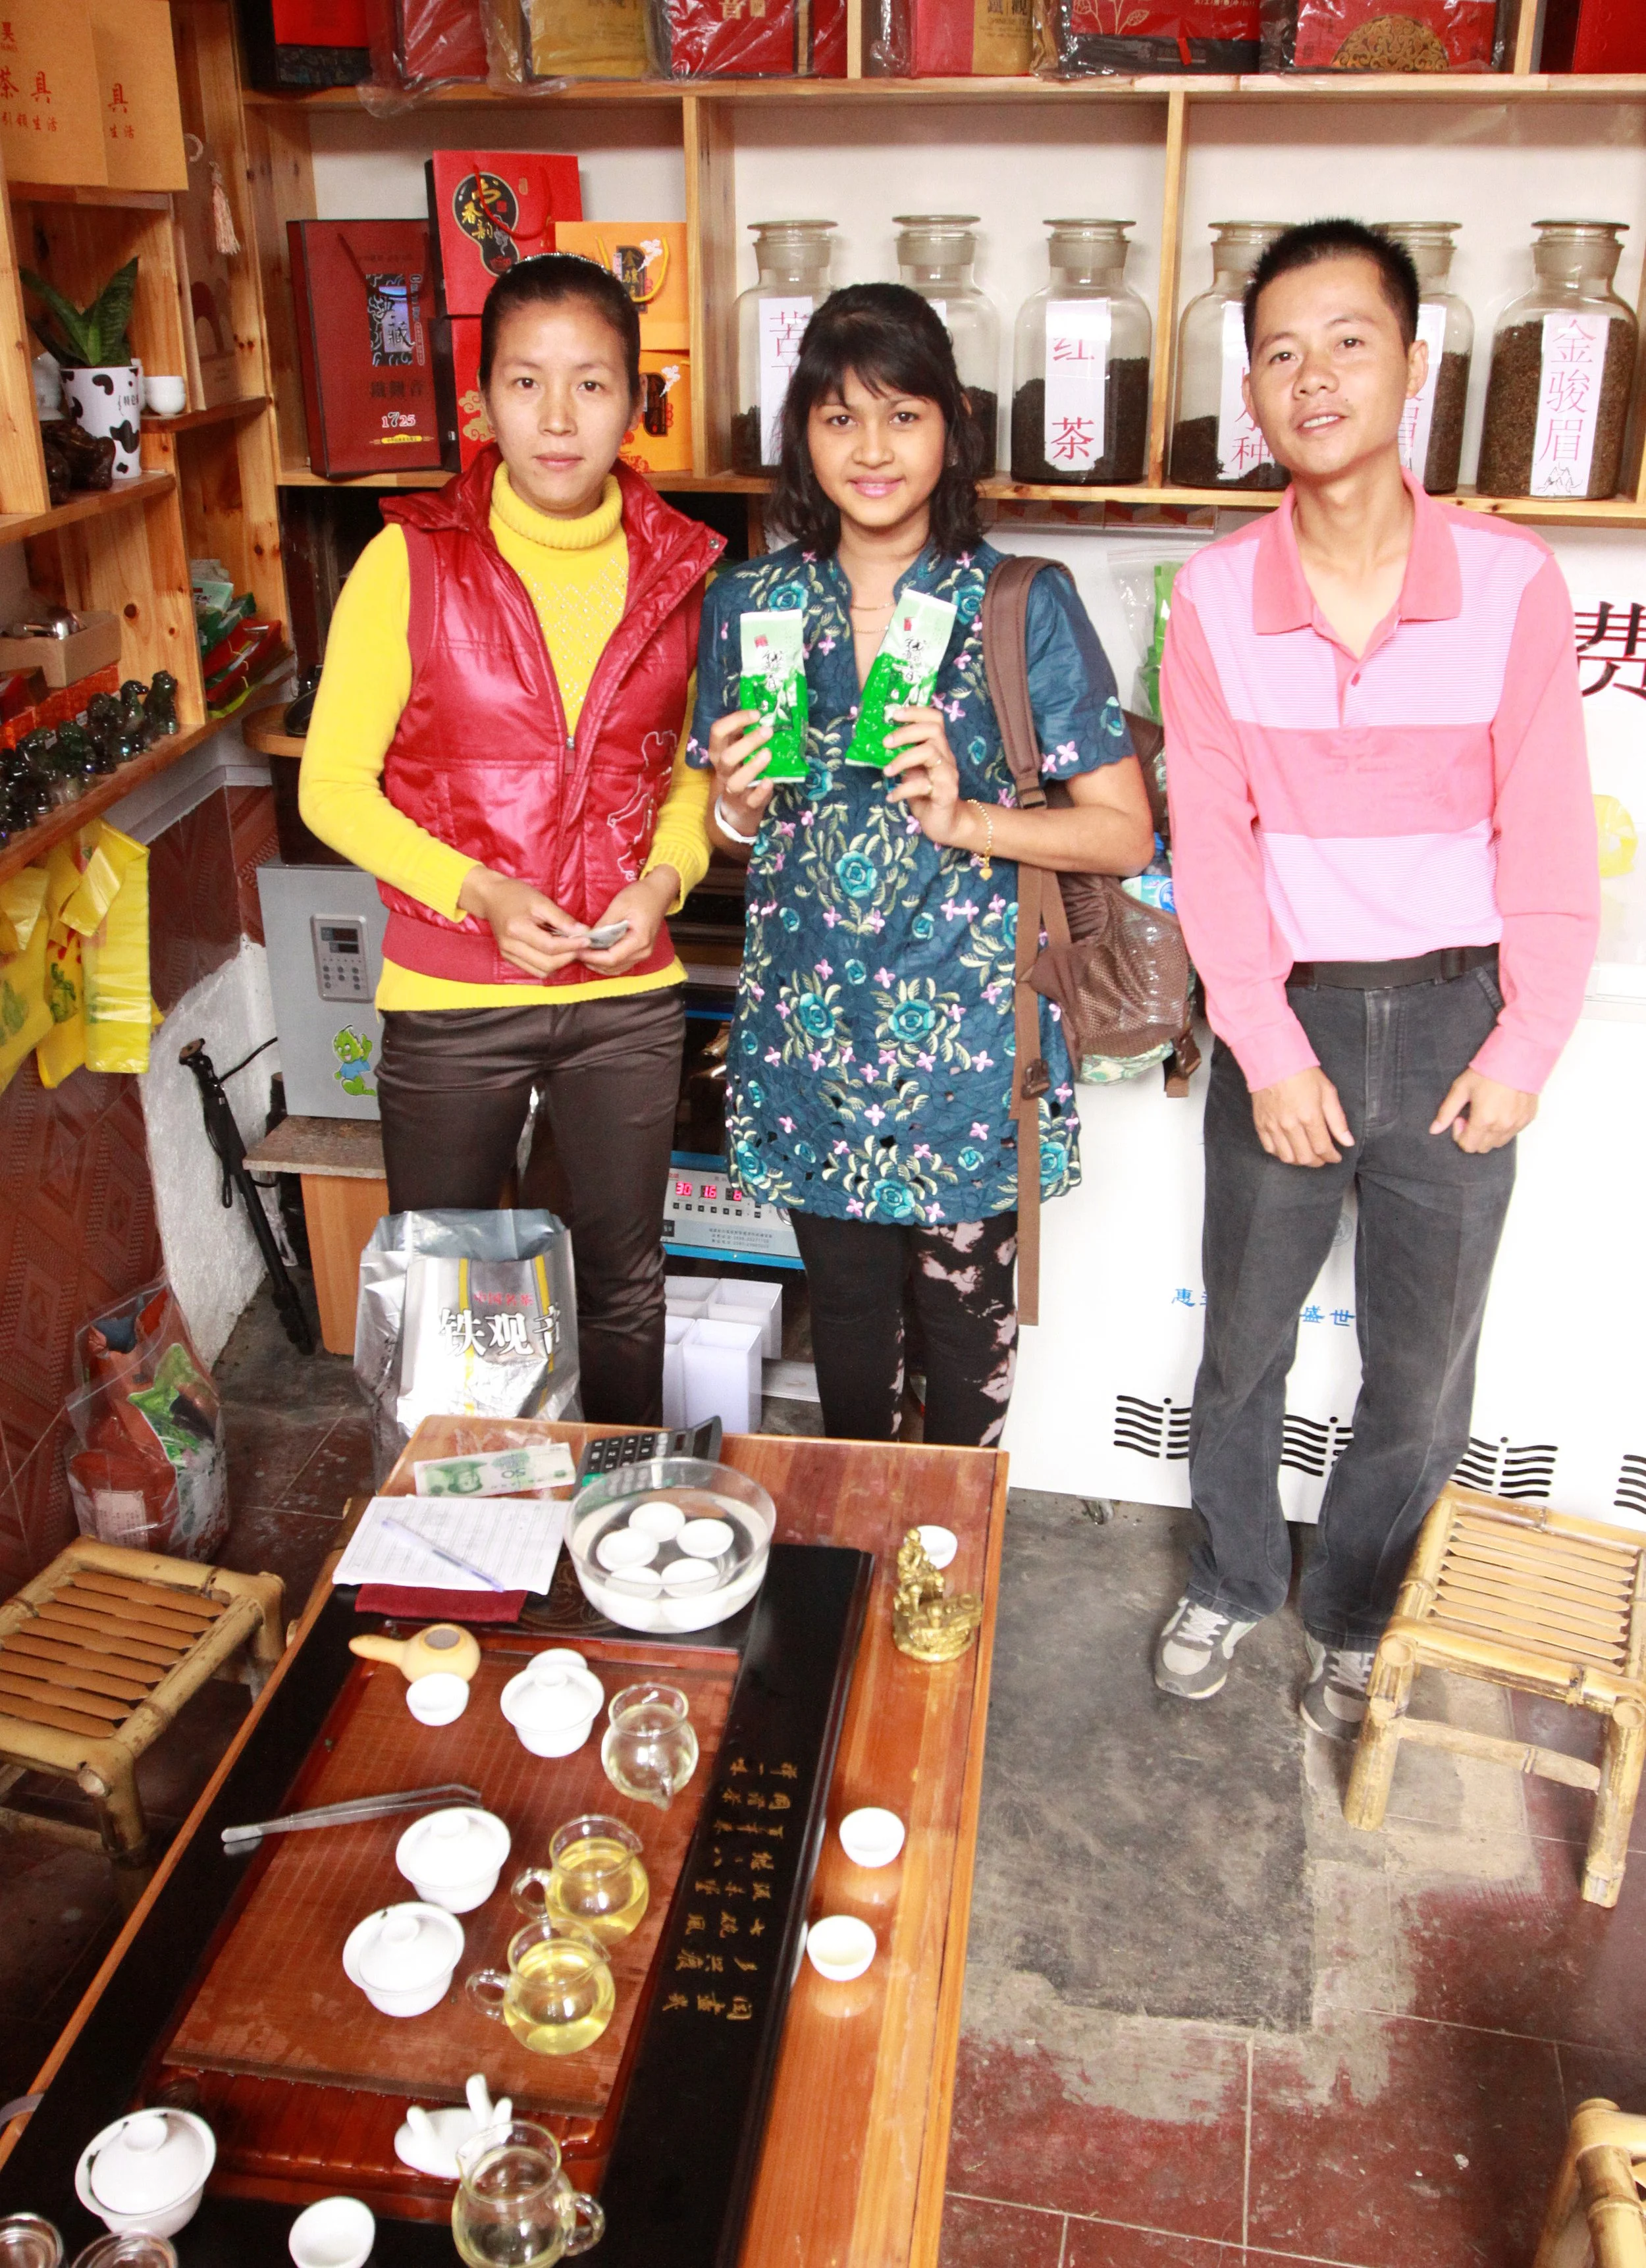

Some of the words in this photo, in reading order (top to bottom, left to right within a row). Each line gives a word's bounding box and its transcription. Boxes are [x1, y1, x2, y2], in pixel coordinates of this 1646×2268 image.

[1539, 319, 1597, 461] 金骏眉
[382, 411, 416, 428] 1725
[676, 1182, 692, 1196] 30
